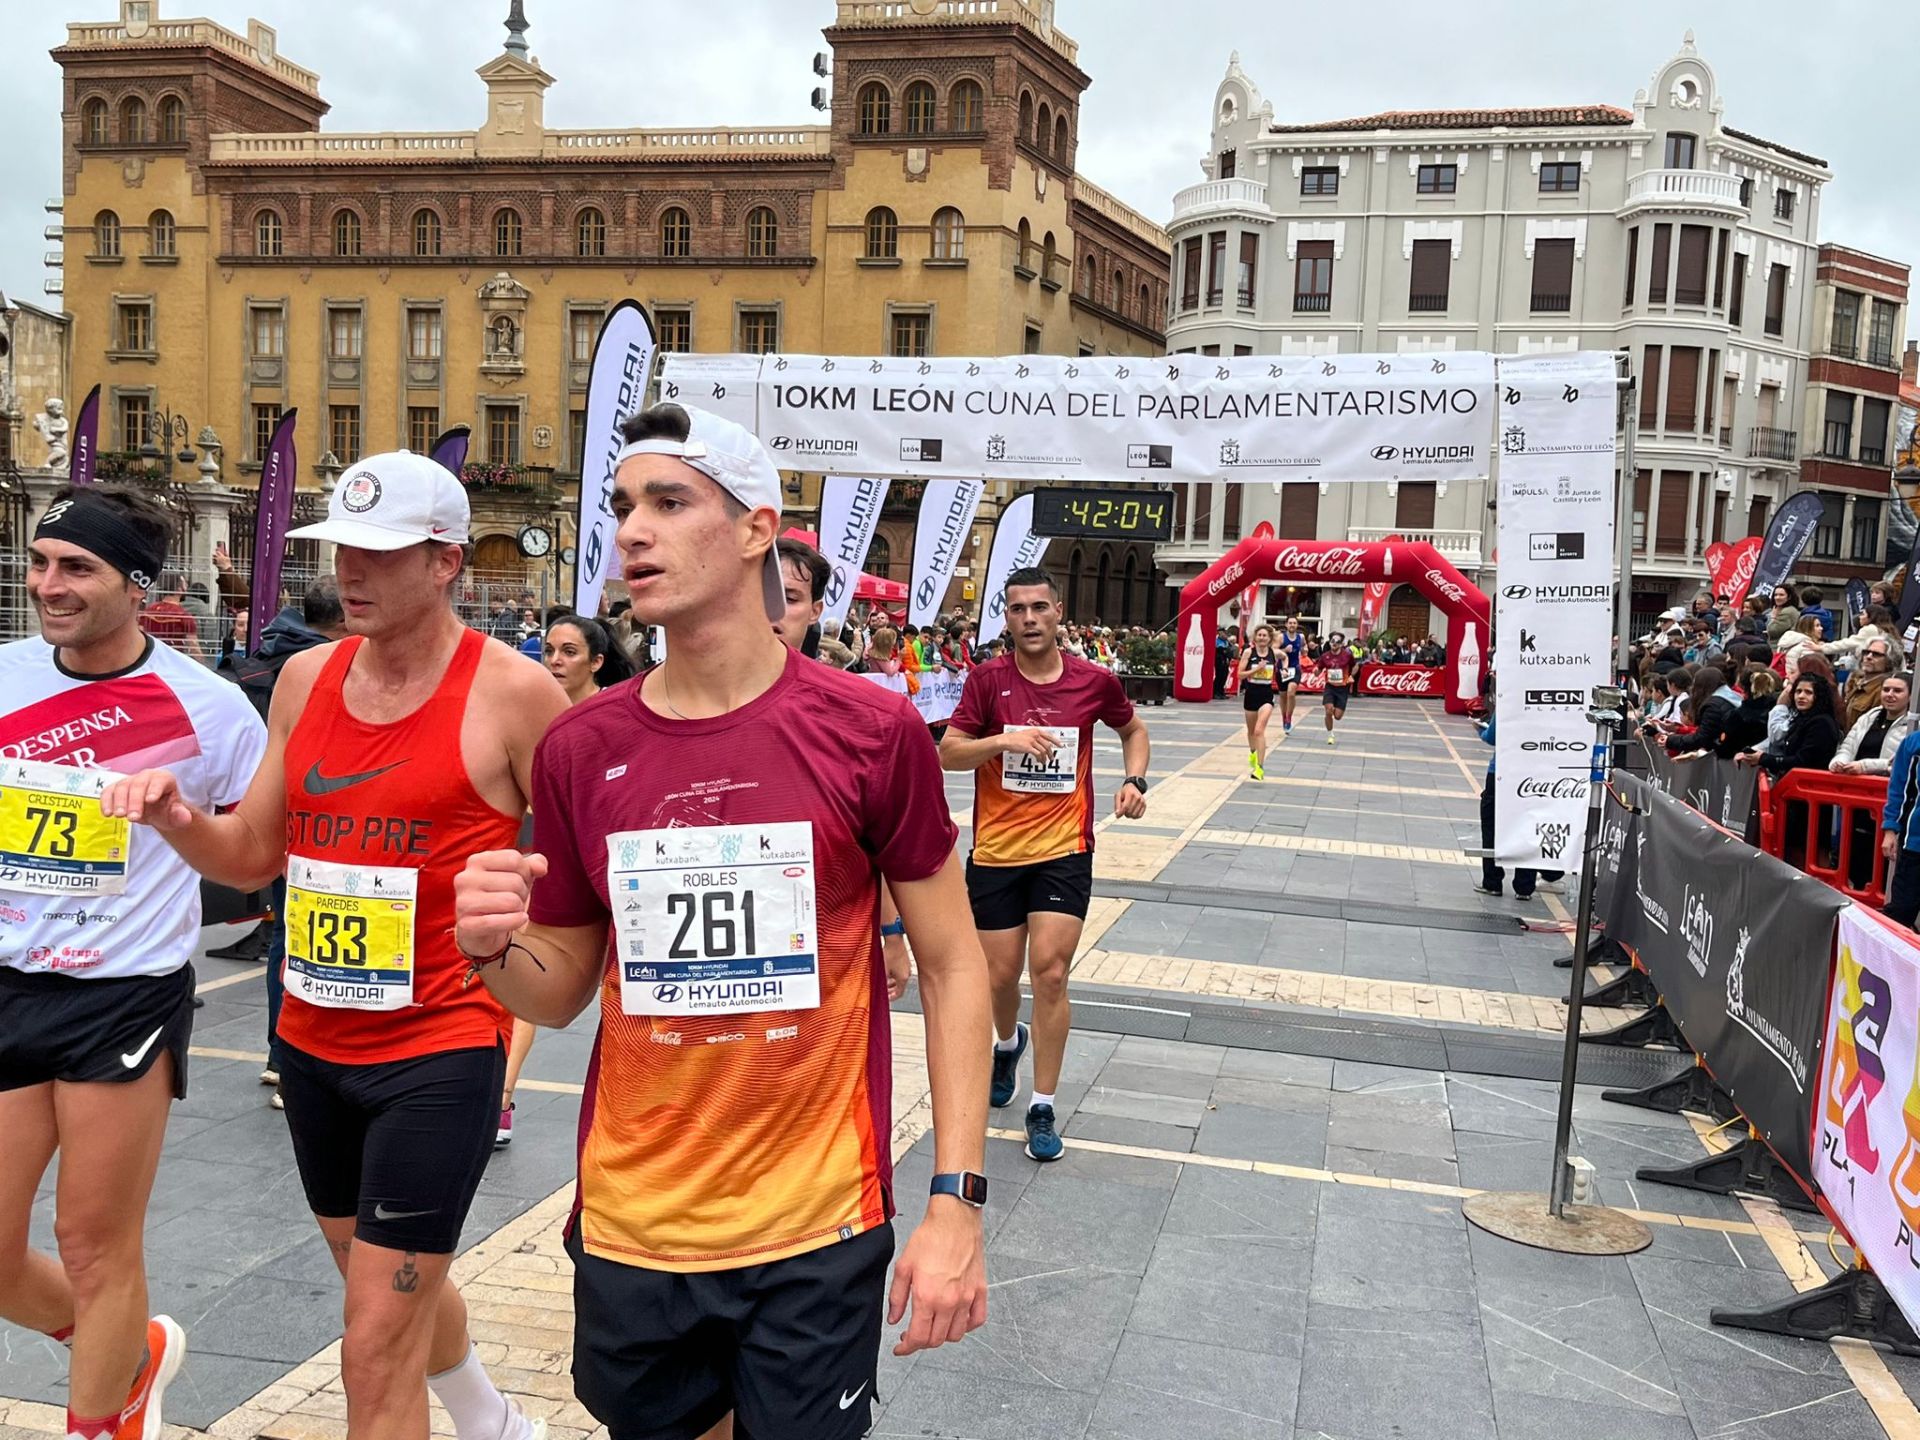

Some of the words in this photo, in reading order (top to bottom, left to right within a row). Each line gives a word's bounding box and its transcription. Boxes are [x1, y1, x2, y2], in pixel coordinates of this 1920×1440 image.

[774, 385, 856, 411] 10KM
[873, 383, 955, 413] LEÓN
[965, 391, 1056, 416] CUNA
[1067, 393, 1126, 417] DEL
[1137, 388, 1477, 419] PARLAMENTARISMO
[796, 439, 858, 451] HYUNDAI
[1403, 446, 1474, 458] HYUNDAI
[79, 435, 88, 485] CLUB
[268, 451, 280, 502] CLUB
[929, 480, 972, 573] HYUNDAI
[941, 538, 958, 576] Lemauto
[956, 485, 979, 539] Automoción
[852, 522, 870, 565] Lemauto
[1532, 541, 1555, 550] LEÓN
[1274, 546, 1368, 575] Coca-Cola
[1208, 560, 1245, 596] Coca-Cola
[1425, 569, 1467, 603] Coca-Cola
[1536, 585, 1610, 597] HYUNDAI
[1567, 596, 1610, 604] Automoción
[1519, 653, 1591, 666] kutxabank
[1366, 669, 1434, 692] Coca-Cola
[1527, 691, 1584, 703] LEON
[1520, 736, 1587, 752] emico
[1516, 777, 1590, 799] Coca-Cola
[28, 793, 82, 809] CRISTIAN
[703, 796, 720, 804] 2024
[26, 808, 78, 858] 73
[287, 811, 354, 849] STOP
[360, 816, 433, 855] PRE
[655, 854, 701, 865] kutxabank
[760, 849, 807, 860] kutxabank
[26, 871, 98, 887] HYUNDAI
[683, 872, 738, 888] ROBLES
[317, 897, 359, 912] PAREDES
[667, 890, 756, 959] 261
[308, 911, 367, 967] 133
[703, 969, 757, 977] PARLAMENTARISMO
[315, 982, 384, 999] HYUNDAI
[689, 980, 783, 1000] HYUNDAI
[689, 999, 726, 1009] Lemauto
[729, 997, 783, 1007] Automoción
[1746, 1006, 1792, 1058] AYUNTAMIENTO
